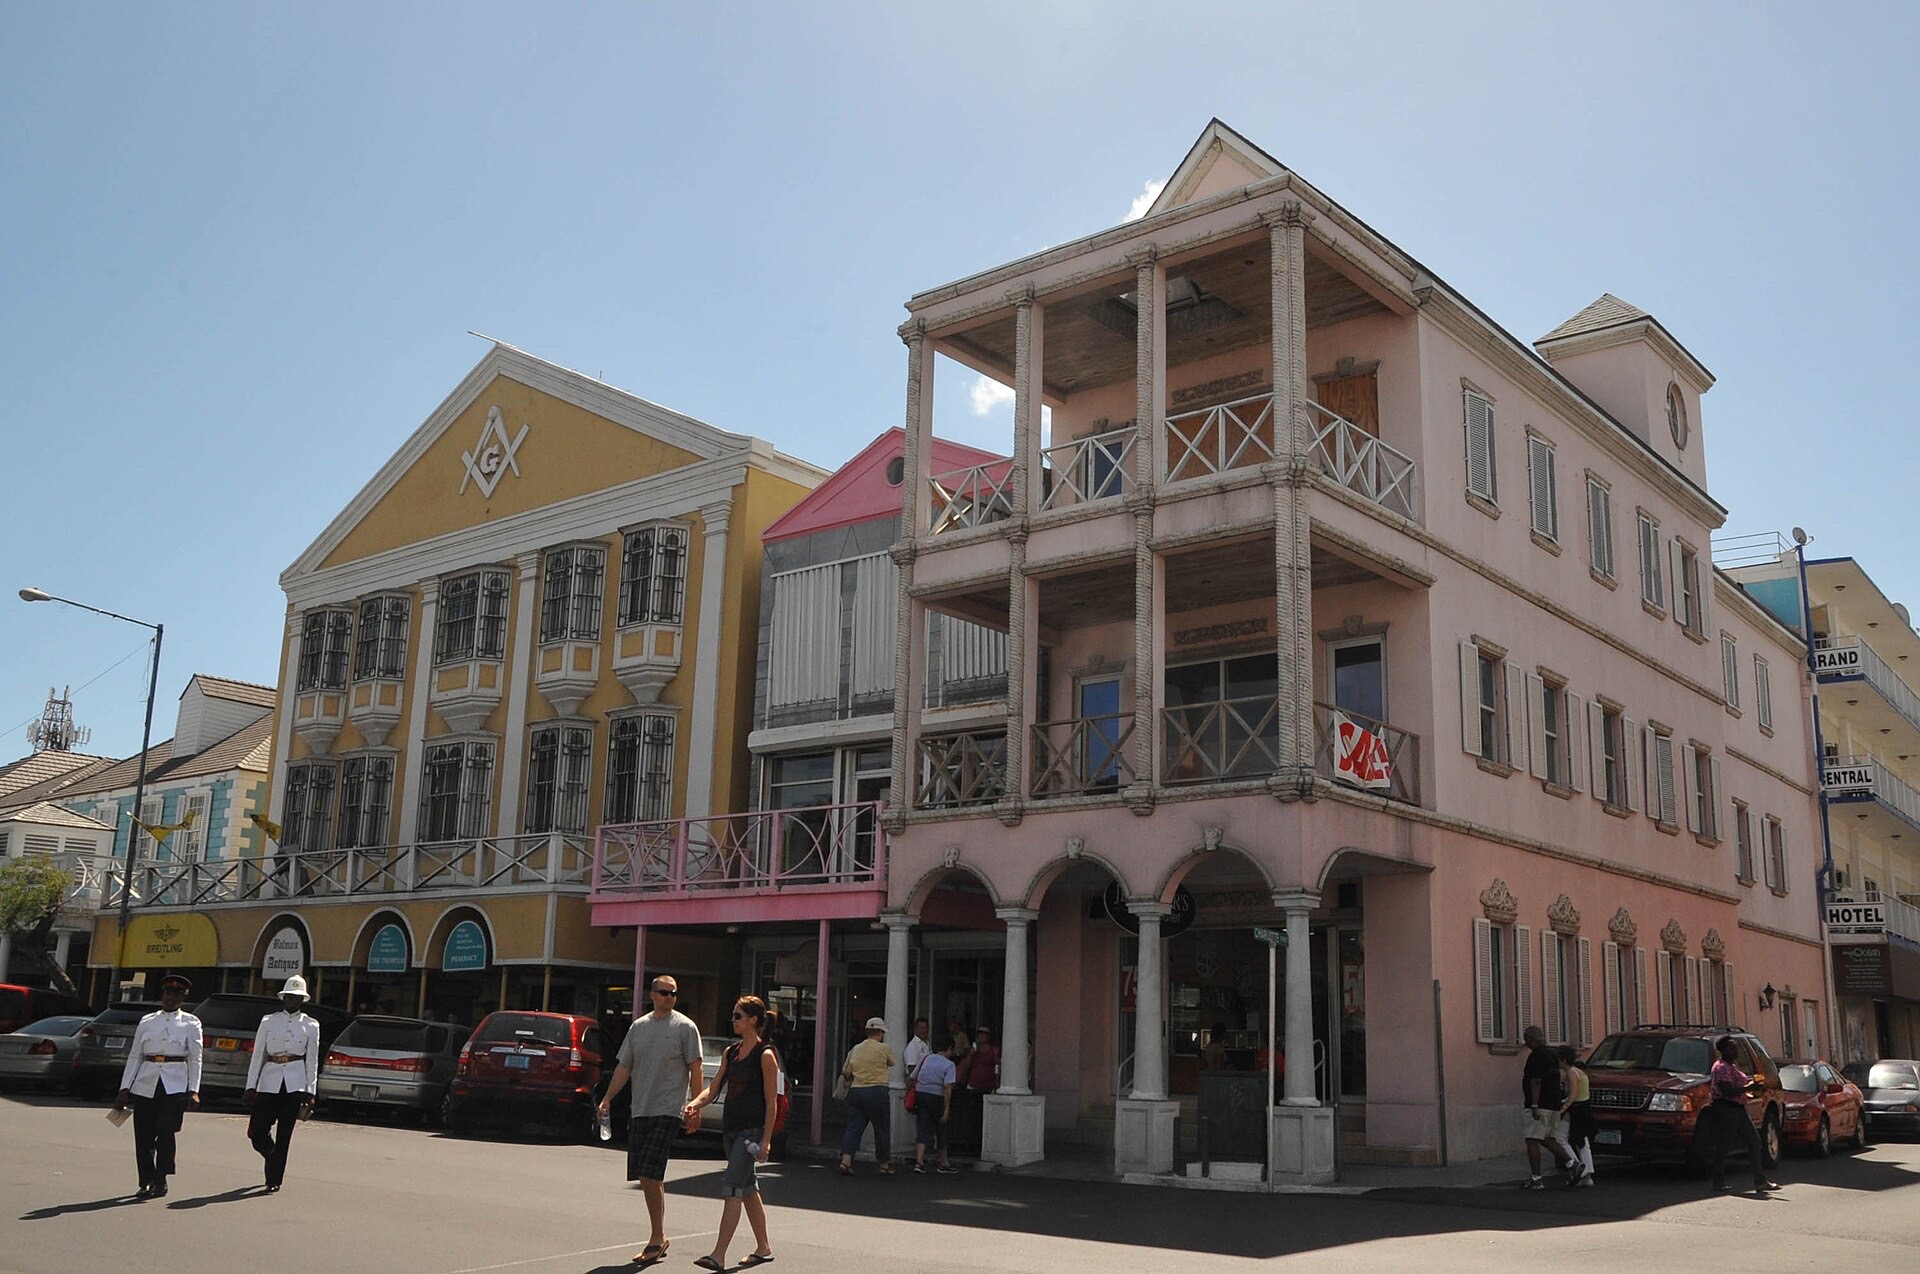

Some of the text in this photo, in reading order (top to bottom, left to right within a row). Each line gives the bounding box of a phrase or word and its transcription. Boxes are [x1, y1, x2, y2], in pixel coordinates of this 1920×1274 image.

[1823, 769, 1873, 786] ENTRAL
[1829, 908, 1885, 923] HOTEL
[146, 944, 183, 954] BREITLING
[267, 956, 300, 973] Antiques
[451, 954, 477, 963] PHARMACY
